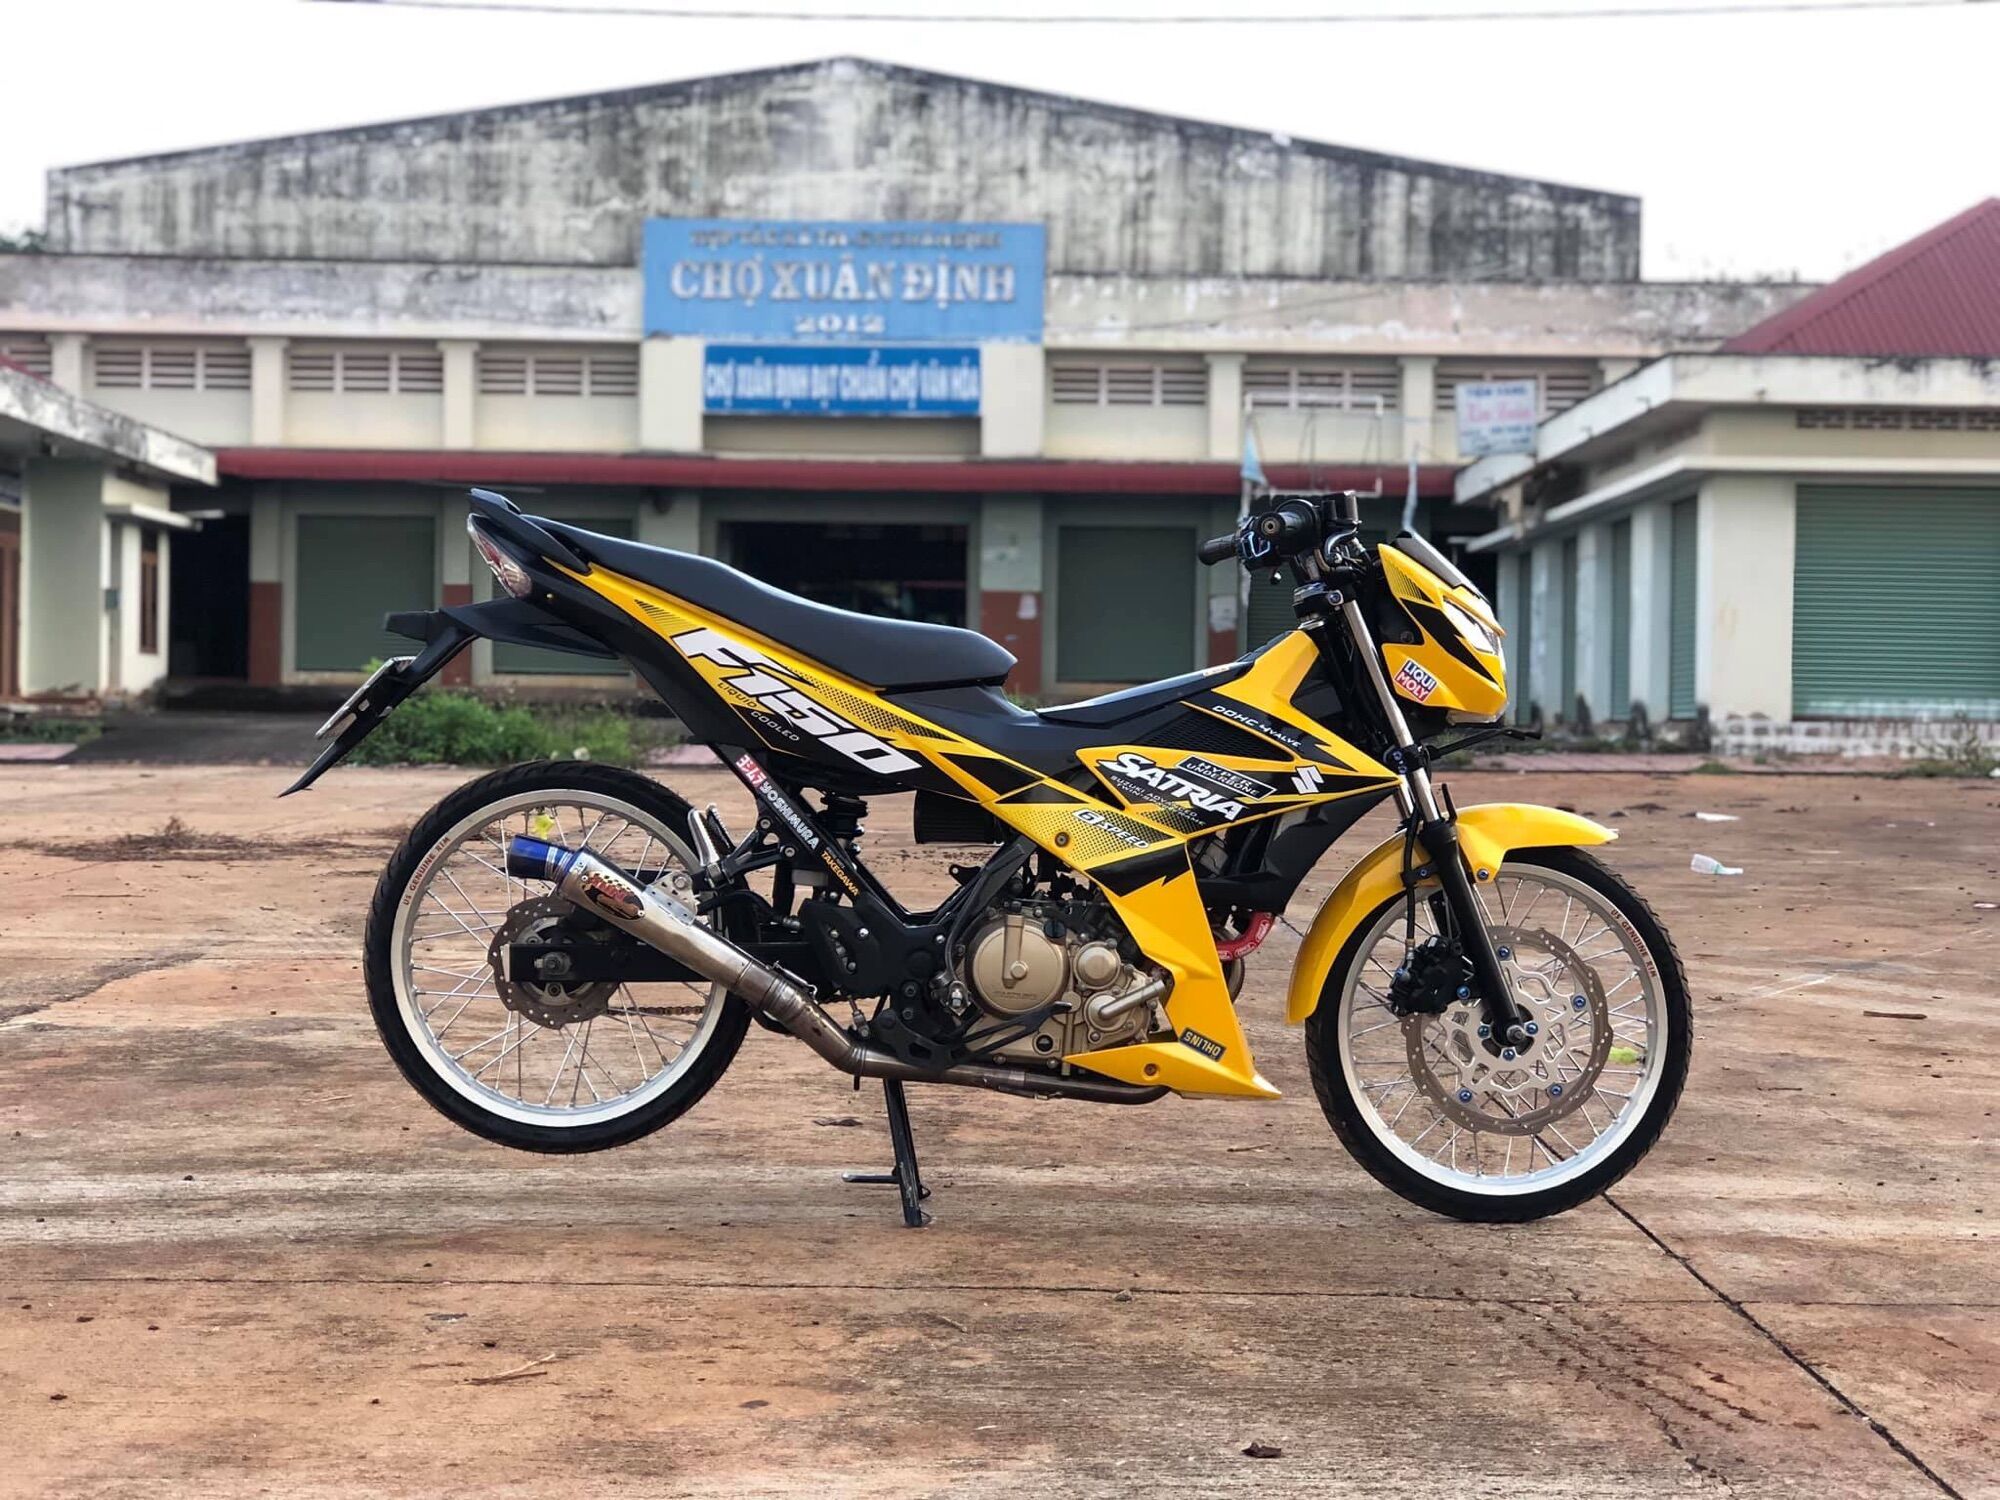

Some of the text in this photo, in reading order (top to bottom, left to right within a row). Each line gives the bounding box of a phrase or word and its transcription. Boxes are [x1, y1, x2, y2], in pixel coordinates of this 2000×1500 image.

[671, 252, 1016, 309] CHỢ XUÂN ĐỊNH
[1396, 671, 1429, 699] MOLY
[1404, 662, 1436, 690] LIQUI
[672, 628, 922, 774] F150
[717, 682, 757, 708] LIQUID
[750, 710, 800, 741] COOLED
[1212, 705, 1259, 726] DOHC
[1098, 752, 1250, 820] SATRIA
[1111, 775, 1145, 793] SUZUKI
[1186, 763, 1260, 796] UNDERBONE
[1198, 762, 1252, 787] HYPER
[760, 780, 820, 850] YOSHIMURA
[403, 836, 450, 905] US GENUINE RIM
[821, 851, 861, 897] TAKEGAWA
[1610, 909, 1621, 919] US
[1621, 921, 1648, 957] GENUINE
